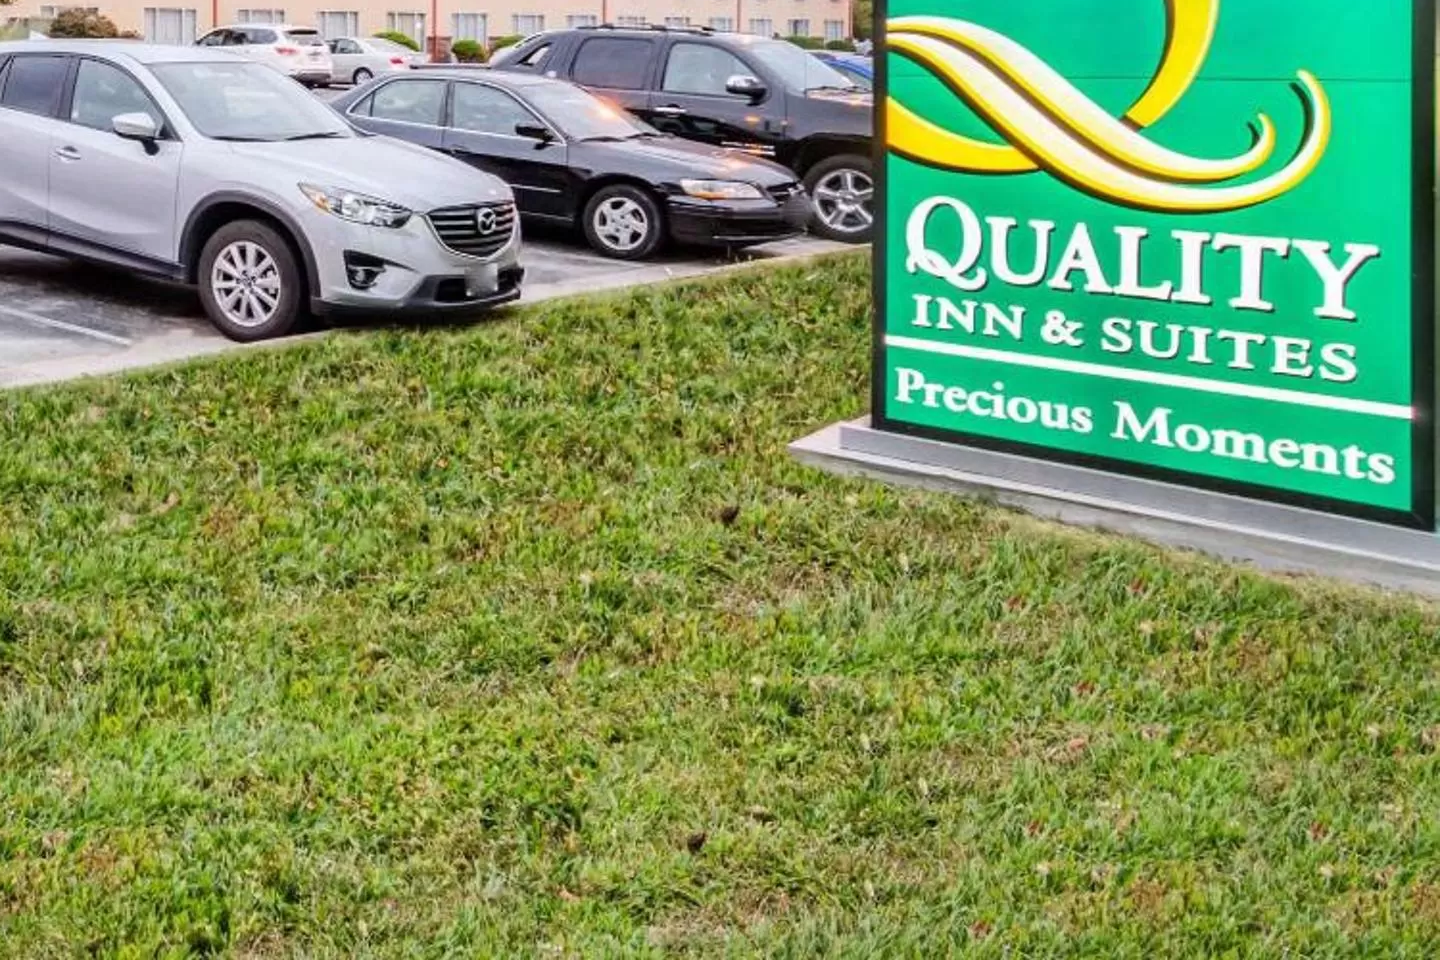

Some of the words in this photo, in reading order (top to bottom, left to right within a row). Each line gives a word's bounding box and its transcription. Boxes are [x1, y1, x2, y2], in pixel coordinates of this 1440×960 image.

[905, 195, 1380, 320] QUALITY
[912, 293, 1026, 339] INN
[1041, 310, 1084, 348] &
[1101, 317, 1357, 382] SUITES
[895, 368, 1093, 433] Precious
[1110, 401, 1396, 485] Moments
